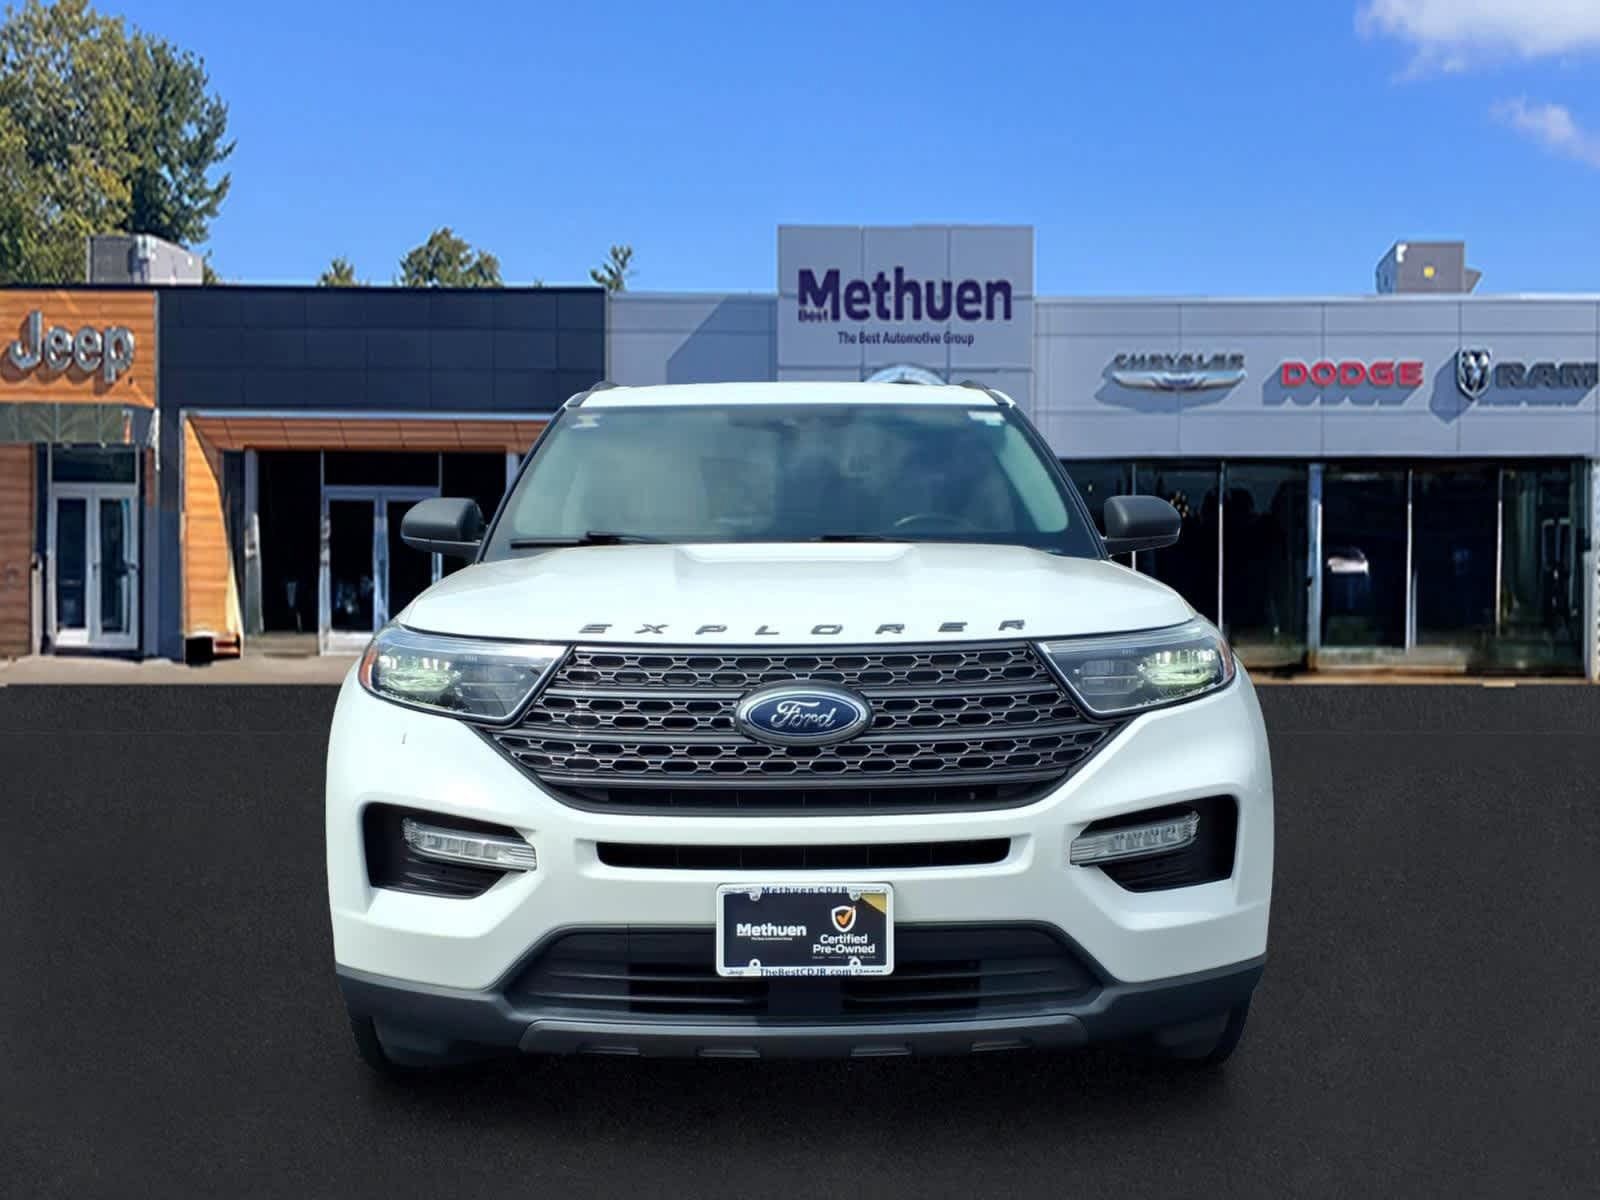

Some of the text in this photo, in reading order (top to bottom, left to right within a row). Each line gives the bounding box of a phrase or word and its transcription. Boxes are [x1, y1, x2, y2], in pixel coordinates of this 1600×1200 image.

[798, 266, 1012, 321] Methuen
[9, 310, 135, 384] Jeep
[838, 331, 975, 346] The Best Automotive Group
[1114, 353, 1245, 369] CHRYSLER
[1280, 360, 1424, 386] DODGE
[1495, 361, 1598, 389] RAM
[578, 619, 1026, 636] EXPLORER
[770, 700, 837, 728] Ford
[736, 922, 807, 937] Methuen
[820, 933, 868, 944] Certified
[813, 944, 875, 954] Pre-Owned
